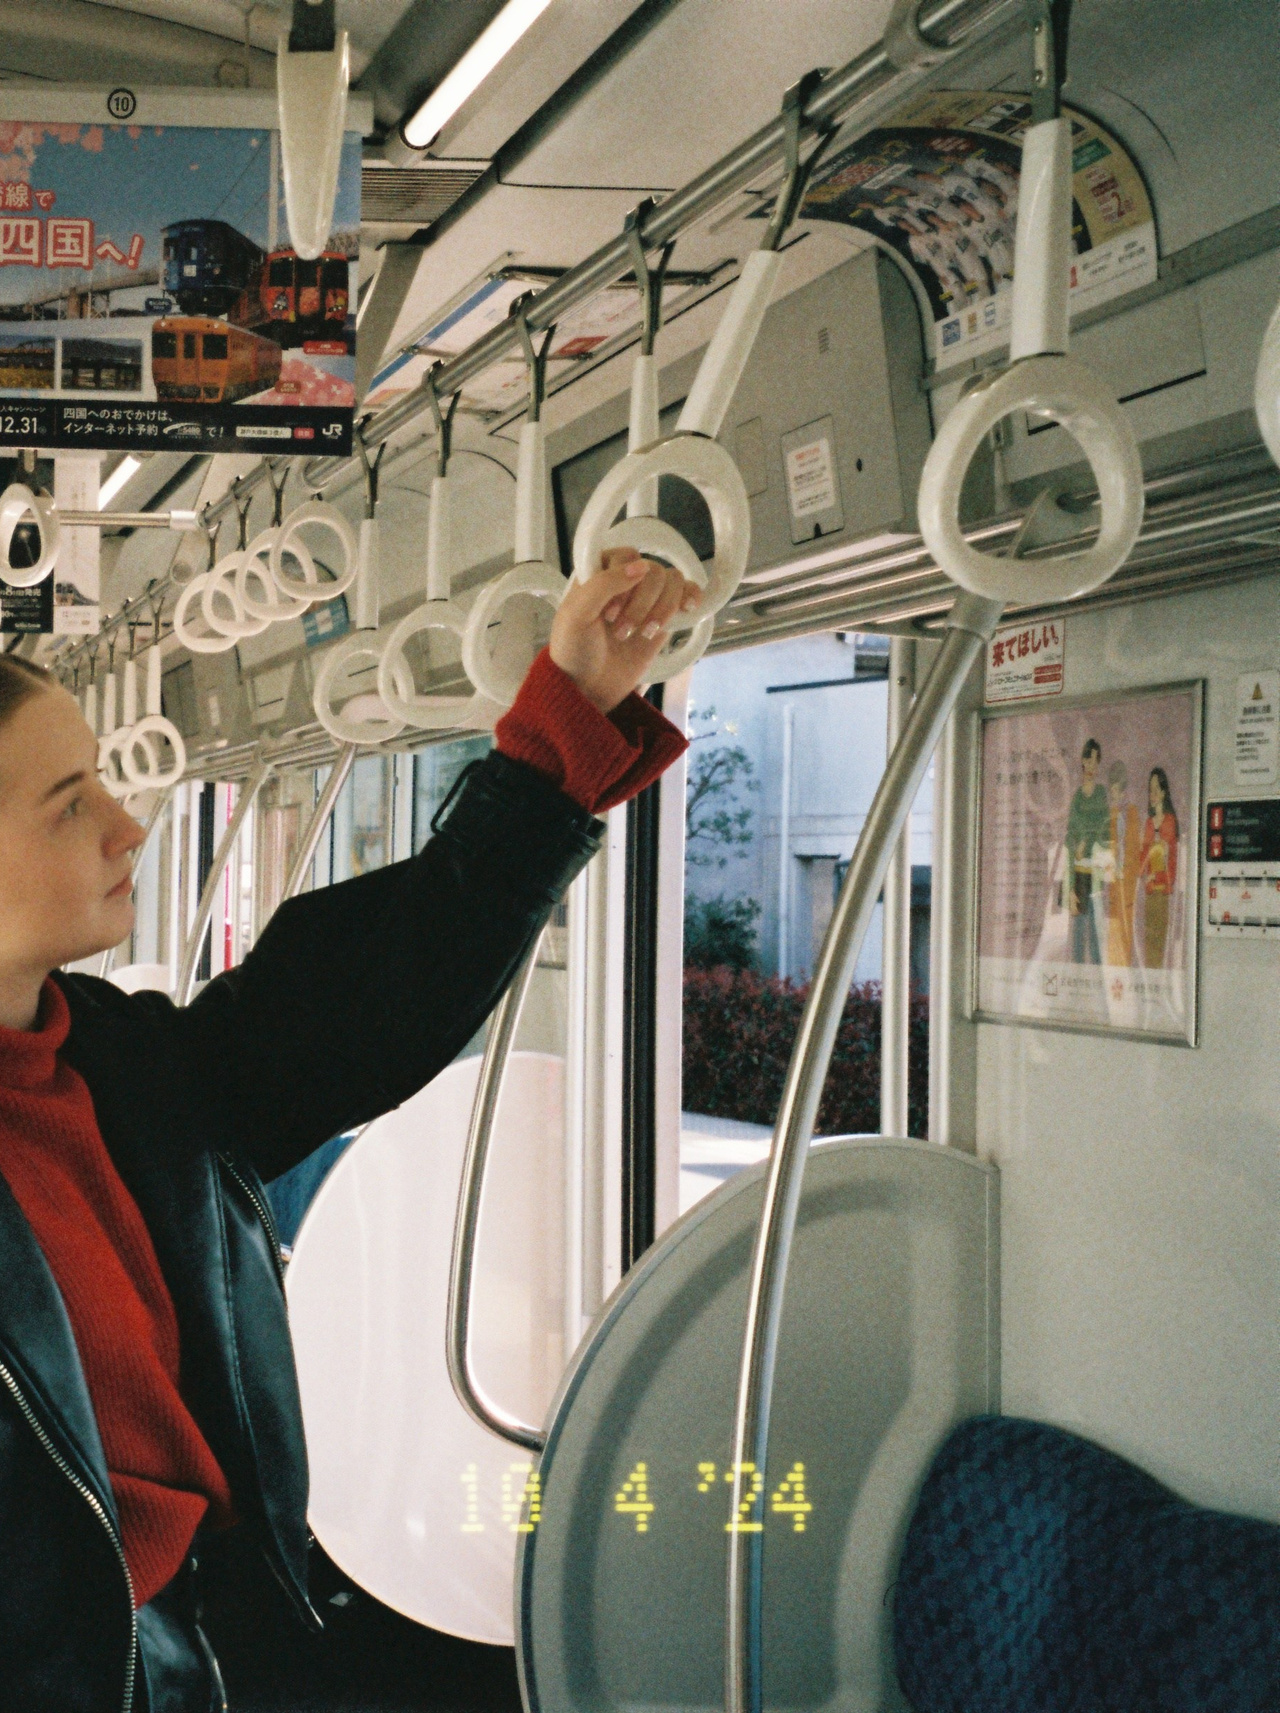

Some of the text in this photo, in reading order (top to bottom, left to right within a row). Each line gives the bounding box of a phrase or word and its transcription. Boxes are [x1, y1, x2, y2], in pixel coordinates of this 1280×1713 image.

[63, 407, 173, 422] 四国へのおでかけは、
[322, 423, 343, 436] JR
[992, 625, 1060, 668] 来てほしい。
